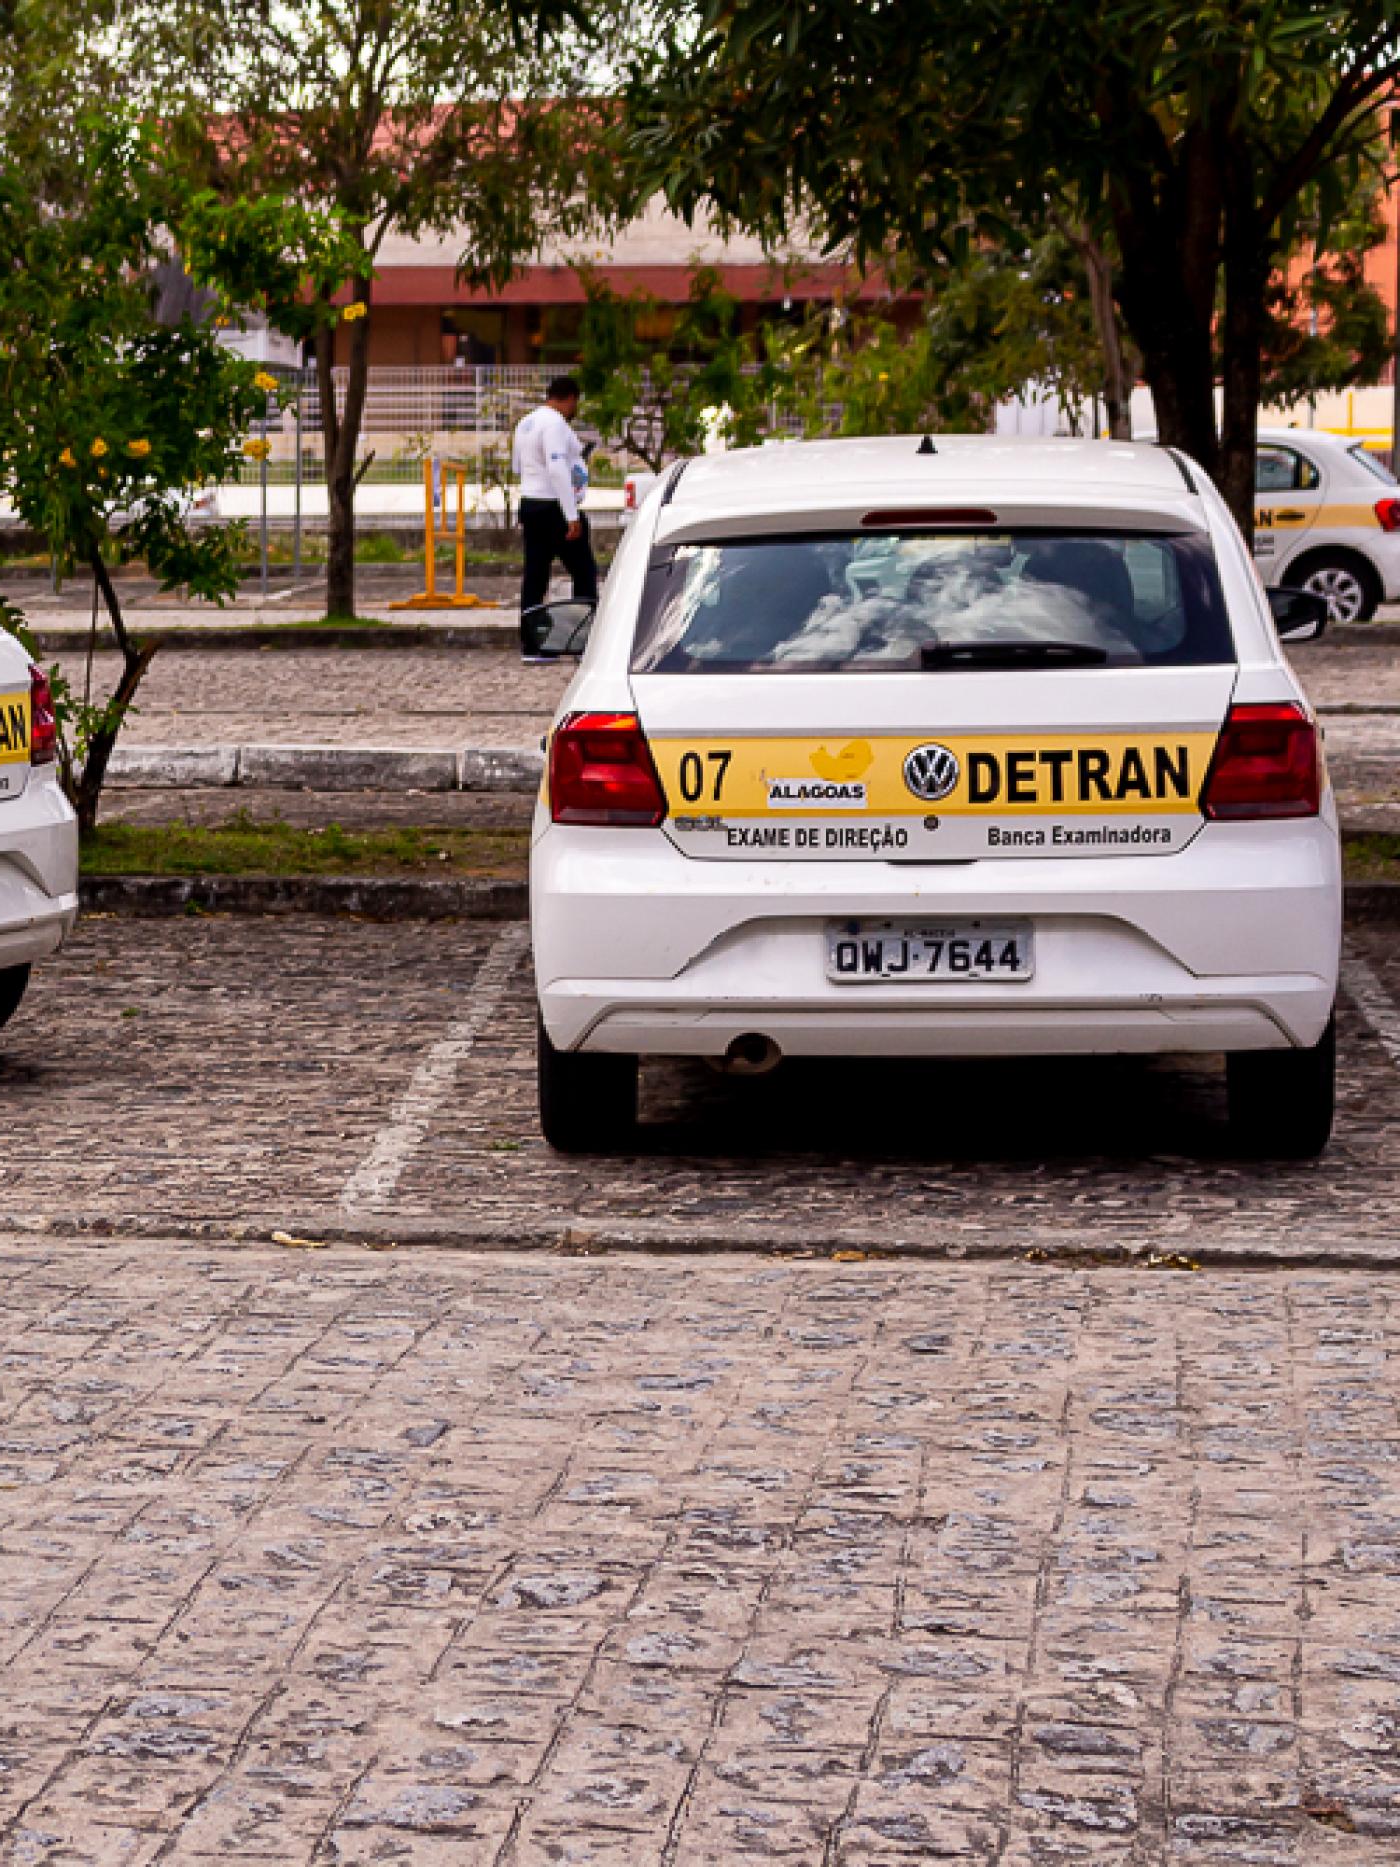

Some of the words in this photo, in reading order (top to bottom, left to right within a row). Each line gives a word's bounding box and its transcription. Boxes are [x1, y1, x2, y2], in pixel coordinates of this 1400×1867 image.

[680, 750, 732, 801] 07
[966, 746, 1190, 804] DETRAN
[768, 783, 865, 800] ALAGOAS
[727, 827, 790, 847] EXAME
[795, 827, 819, 848] DE
[825, 823, 908, 853] DIREÇÃO
[987, 826, 1045, 846] Banca
[1052, 824, 1171, 845] Examinadora
